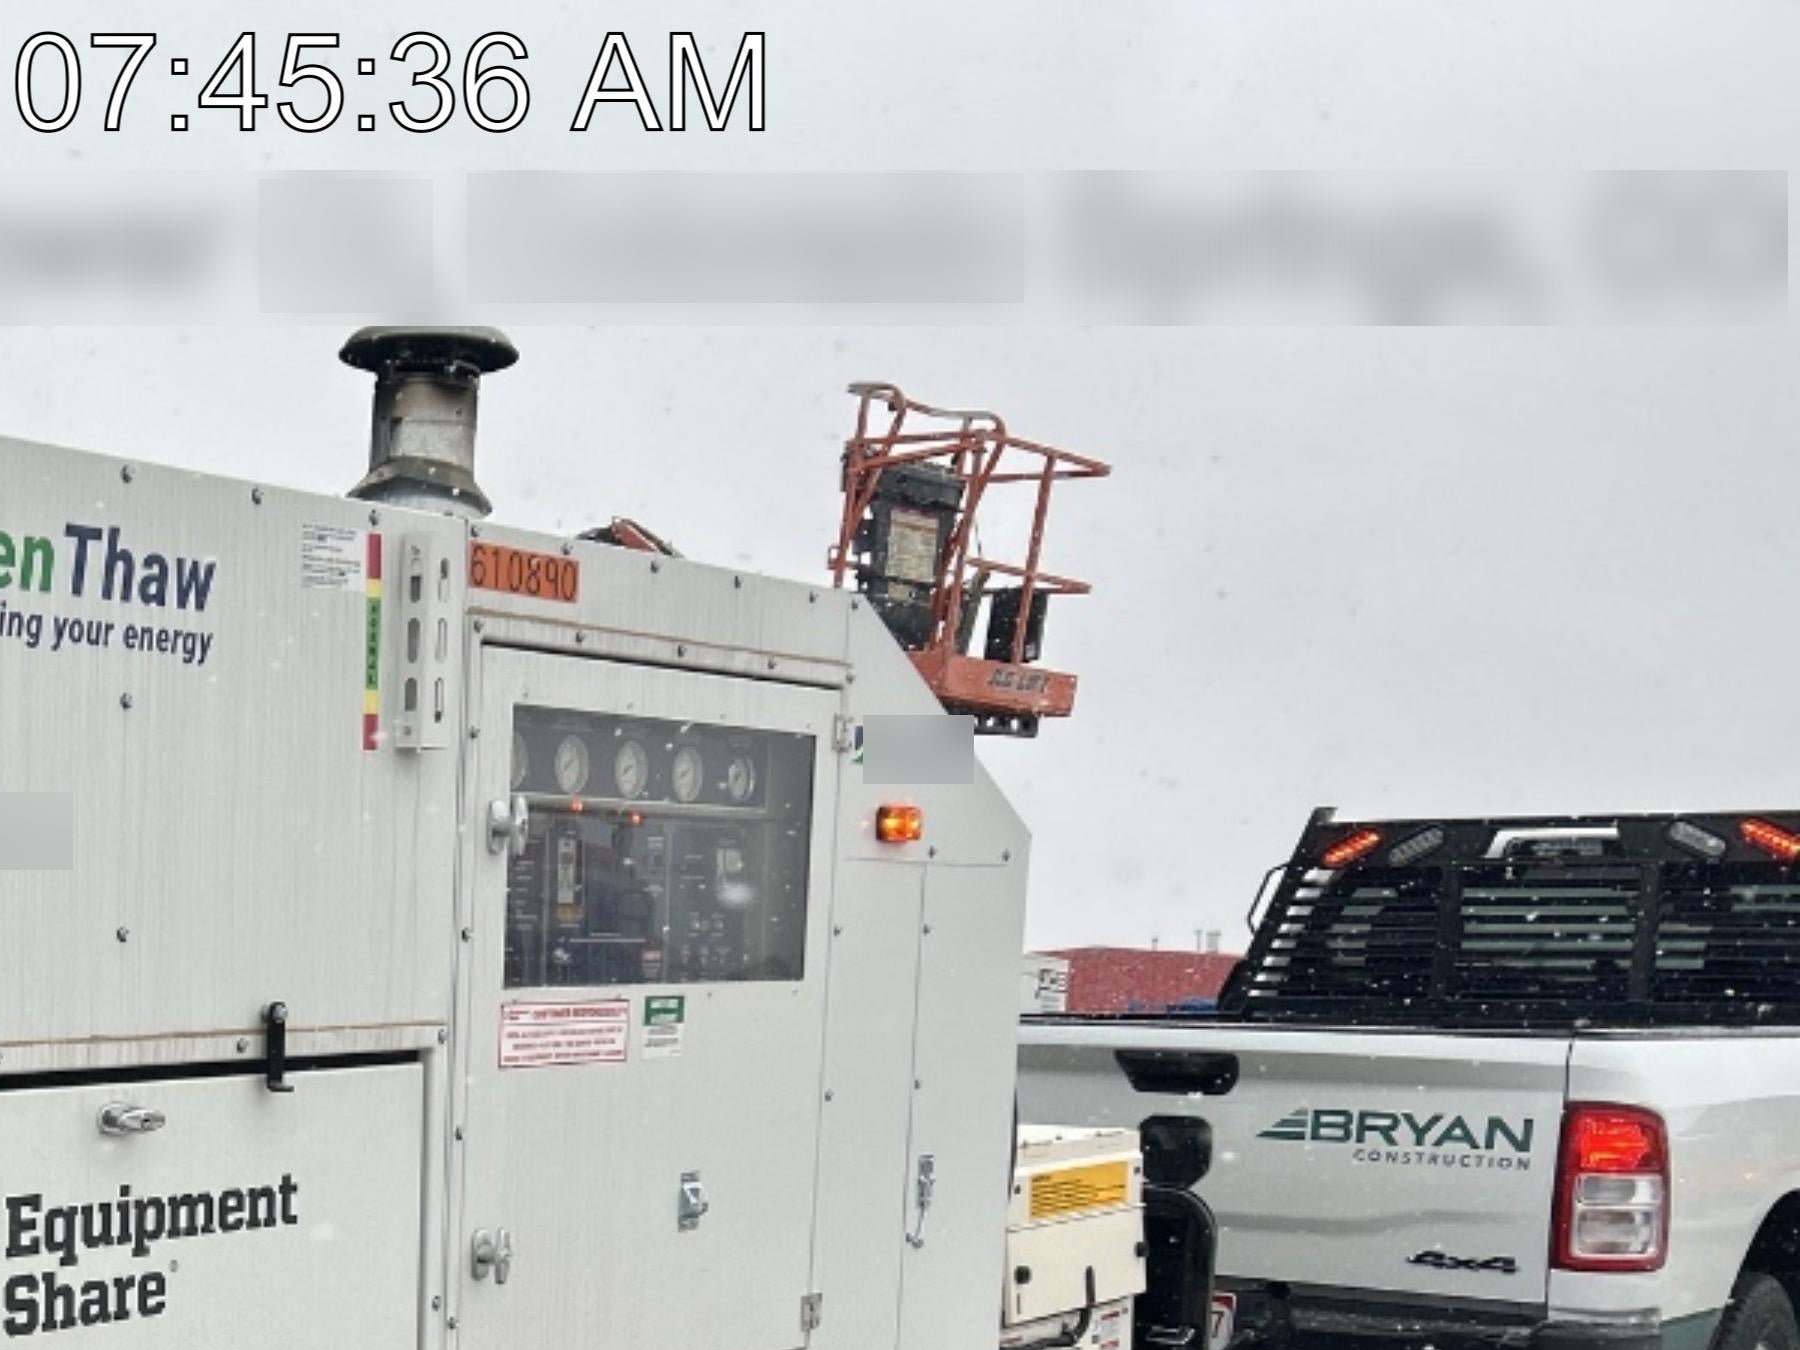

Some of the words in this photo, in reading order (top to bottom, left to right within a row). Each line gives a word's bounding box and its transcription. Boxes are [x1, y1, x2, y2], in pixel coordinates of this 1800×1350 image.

[469, 545, 577, 600] 610890
[51, 615, 114, 650] your
[123, 623, 213, 665] energy
[1310, 1109, 1534, 1152] BRYAN
[1354, 1149, 1531, 1170] CONSTRUCTION
[4, 1173, 299, 1266] Equipment
[1406, 1250, 1519, 1274] 4x4
[2, 1269, 168, 1338] Share
